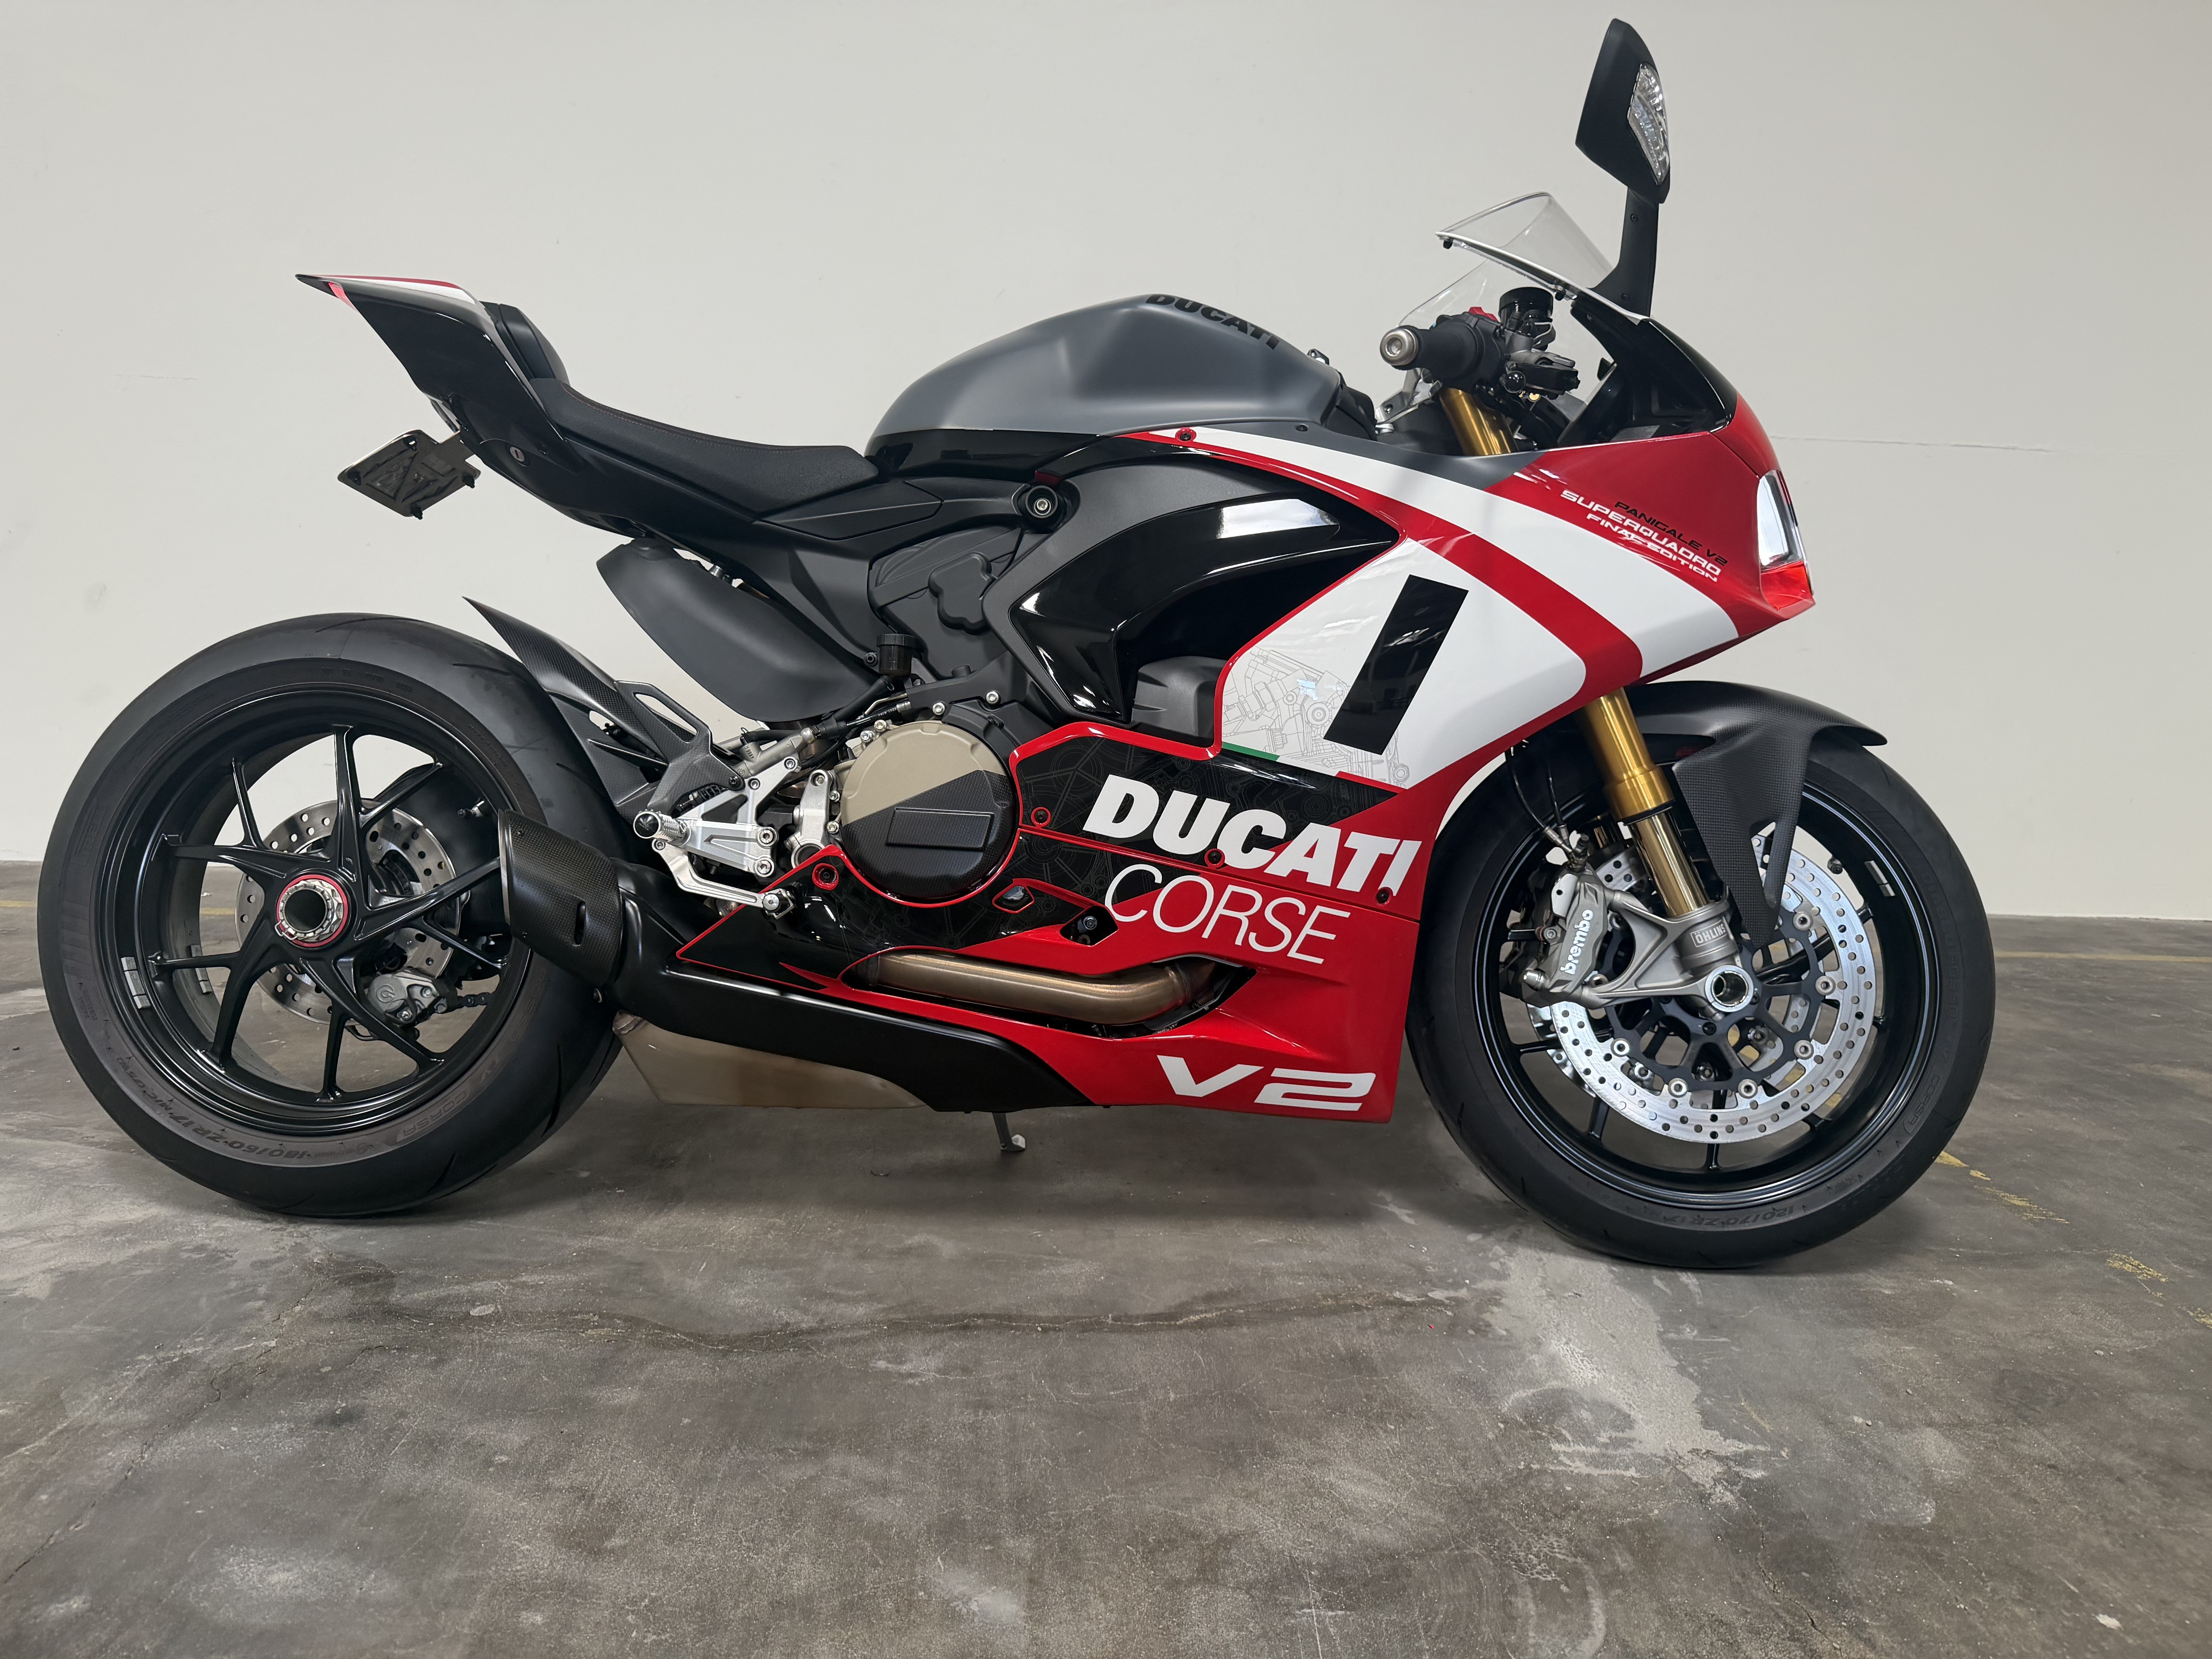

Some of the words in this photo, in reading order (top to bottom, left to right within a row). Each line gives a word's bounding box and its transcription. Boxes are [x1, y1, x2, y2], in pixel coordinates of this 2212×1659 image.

[1146, 294, 1279, 350] DUCATI
[1561, 490, 1721, 575] SUPERQUADRO
[1614, 501, 1702, 550] PANIGALE
[1706, 549, 1728, 566] V2
[1647, 542, 1717, 582] EDITION
[1083, 775, 1422, 896] DUCATI
[1104, 864, 1350, 964] CORSE
[1694, 924, 1726, 943] ÖHLINS
[1560, 910, 1593, 975] brembo
[1157, 1055, 1376, 1111] V2
[1907, 1074, 1940, 1127] CORSA
[404, 1090, 466, 1137] CORSA
